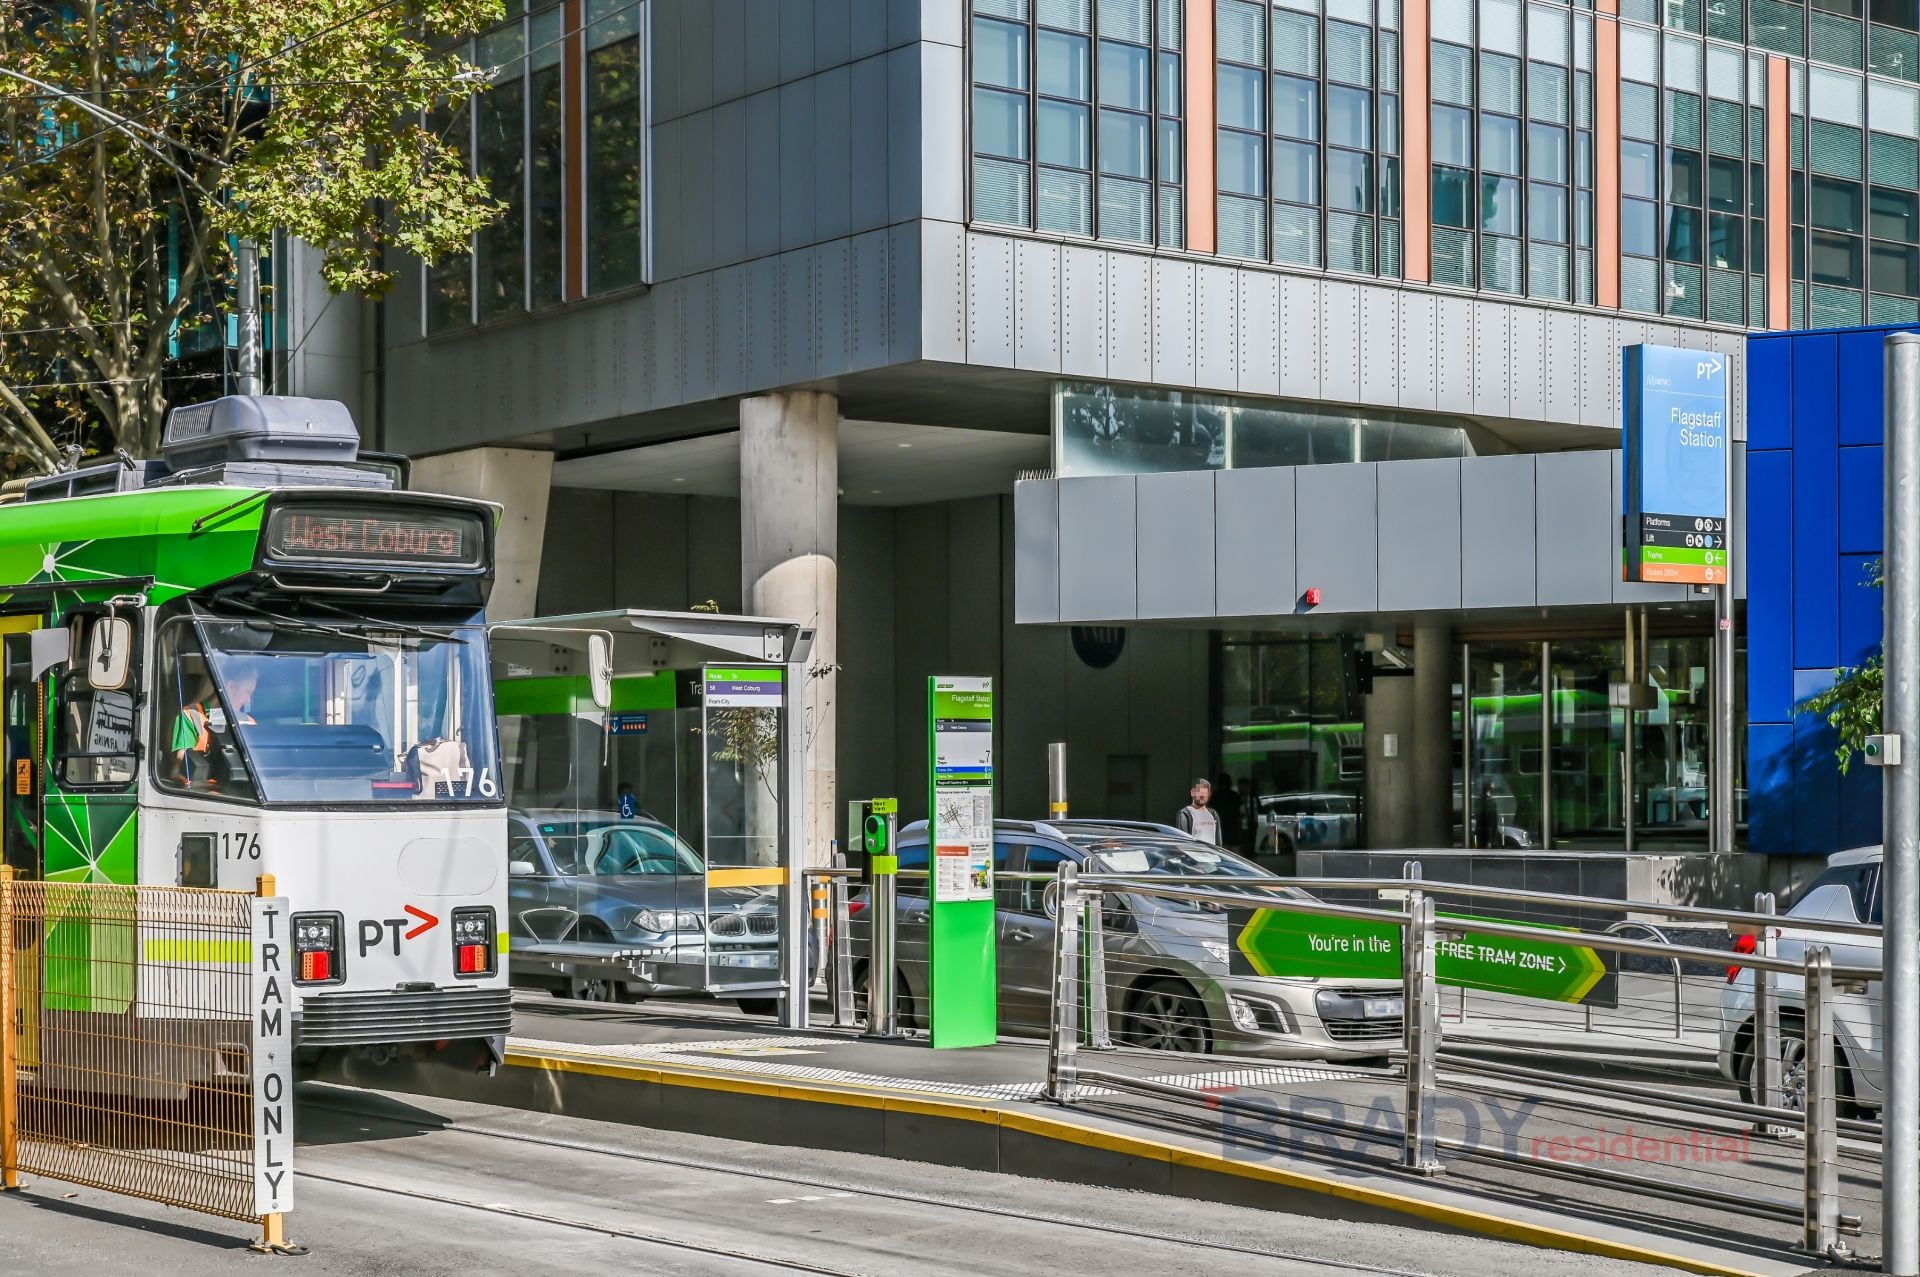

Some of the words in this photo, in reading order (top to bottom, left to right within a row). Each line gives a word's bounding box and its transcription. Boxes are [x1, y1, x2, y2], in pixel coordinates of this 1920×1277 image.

[1671, 407, 1722, 429] Flagstaff
[1680, 428, 1722, 448] Station
[290, 515, 353, 551] West
[362, 518, 454, 555] Coburg
[1646, 517, 1671, 527] Platforms
[1645, 533, 1655, 543] Lift
[440, 767, 497, 797] 176
[222, 832, 261, 861] 176
[1308, 933, 1349, 952] You're
[1352, 934, 1365, 952] in
[1368, 935, 1391, 953] the
[1441, 941, 1475, 961] FREE
[1477, 946, 1516, 966] TRAM
[1518, 951, 1555, 972] ZONE
[260, 910, 283, 1038] TRAM
[263, 1072, 285, 1200] ONLY
